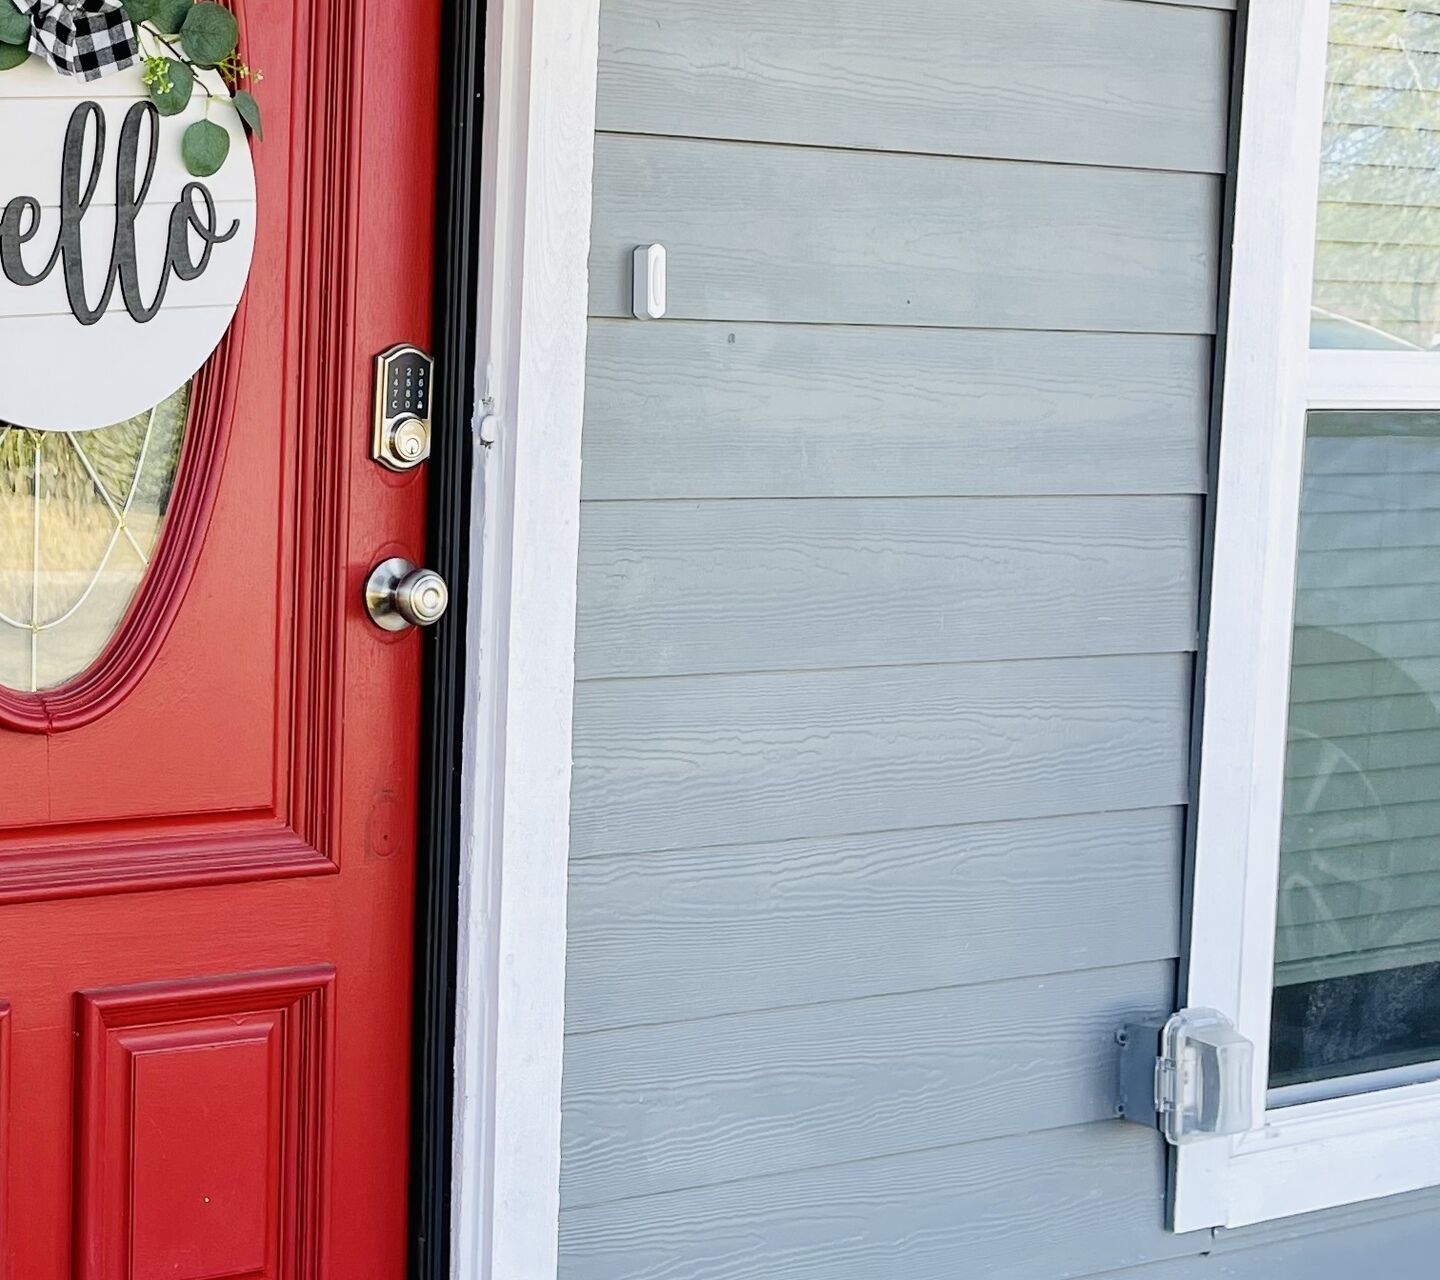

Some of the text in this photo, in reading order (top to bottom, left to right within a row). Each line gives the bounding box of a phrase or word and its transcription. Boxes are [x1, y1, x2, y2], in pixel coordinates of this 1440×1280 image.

[406, 367, 412, 376] 2
[419, 368, 424, 376] 3
[393, 378, 424, 387] 4 5 6
[393, 389, 424, 398] 7 8 9
[392, 400, 398, 409] C
